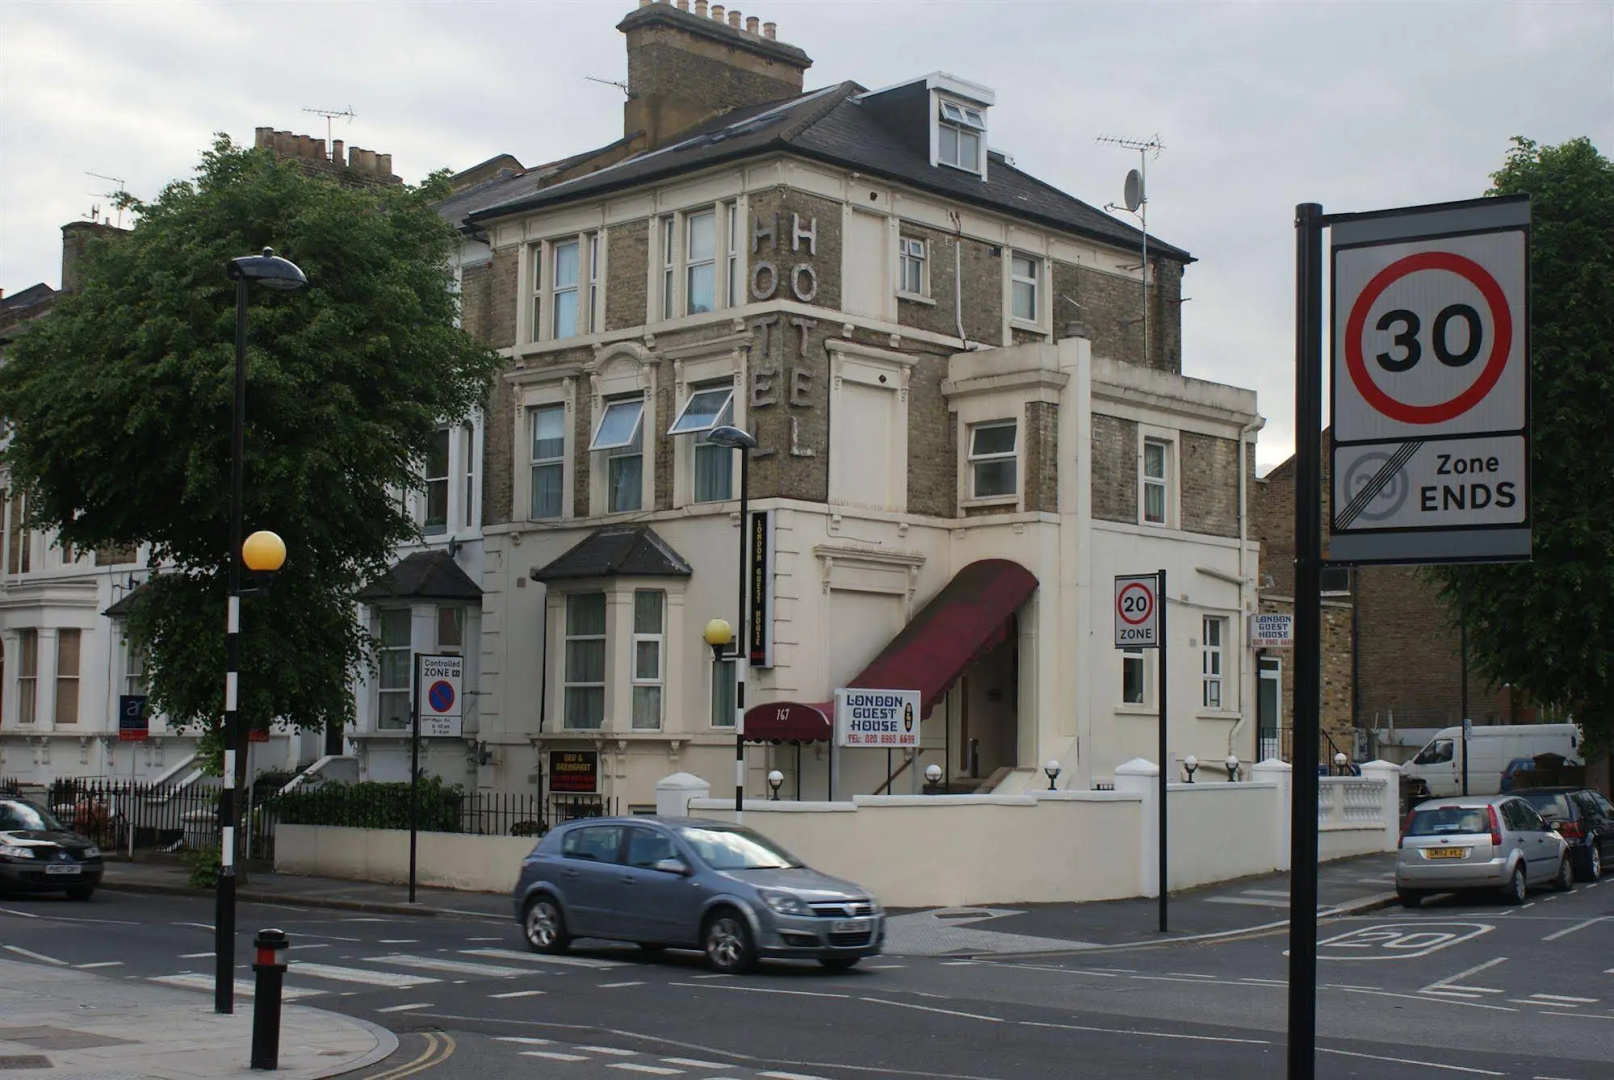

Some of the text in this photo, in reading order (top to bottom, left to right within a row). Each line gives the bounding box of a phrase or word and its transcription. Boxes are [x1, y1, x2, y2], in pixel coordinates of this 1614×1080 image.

[751, 212, 779, 457] HOTEL
[791, 212, 817, 457] HOTEL
[1375, 303, 1483, 372] 30
[1437, 453, 1499, 475] Zone
[1420, 481, 1516, 511] ENDS
[1124, 596, 1147, 612] 20
[1255, 615, 1291, 623] LONDON
[1120, 628, 1152, 640] ZONE
[424, 659, 461, 667] Controlled
[424, 668, 450, 677] ZONE
[847, 695, 903, 707] LONDON
[776, 708, 790, 721] 167
[853, 707, 897, 719] GUEST
[850, 720, 898, 732] HOUSE
[1323, 932, 1457, 948] 20
